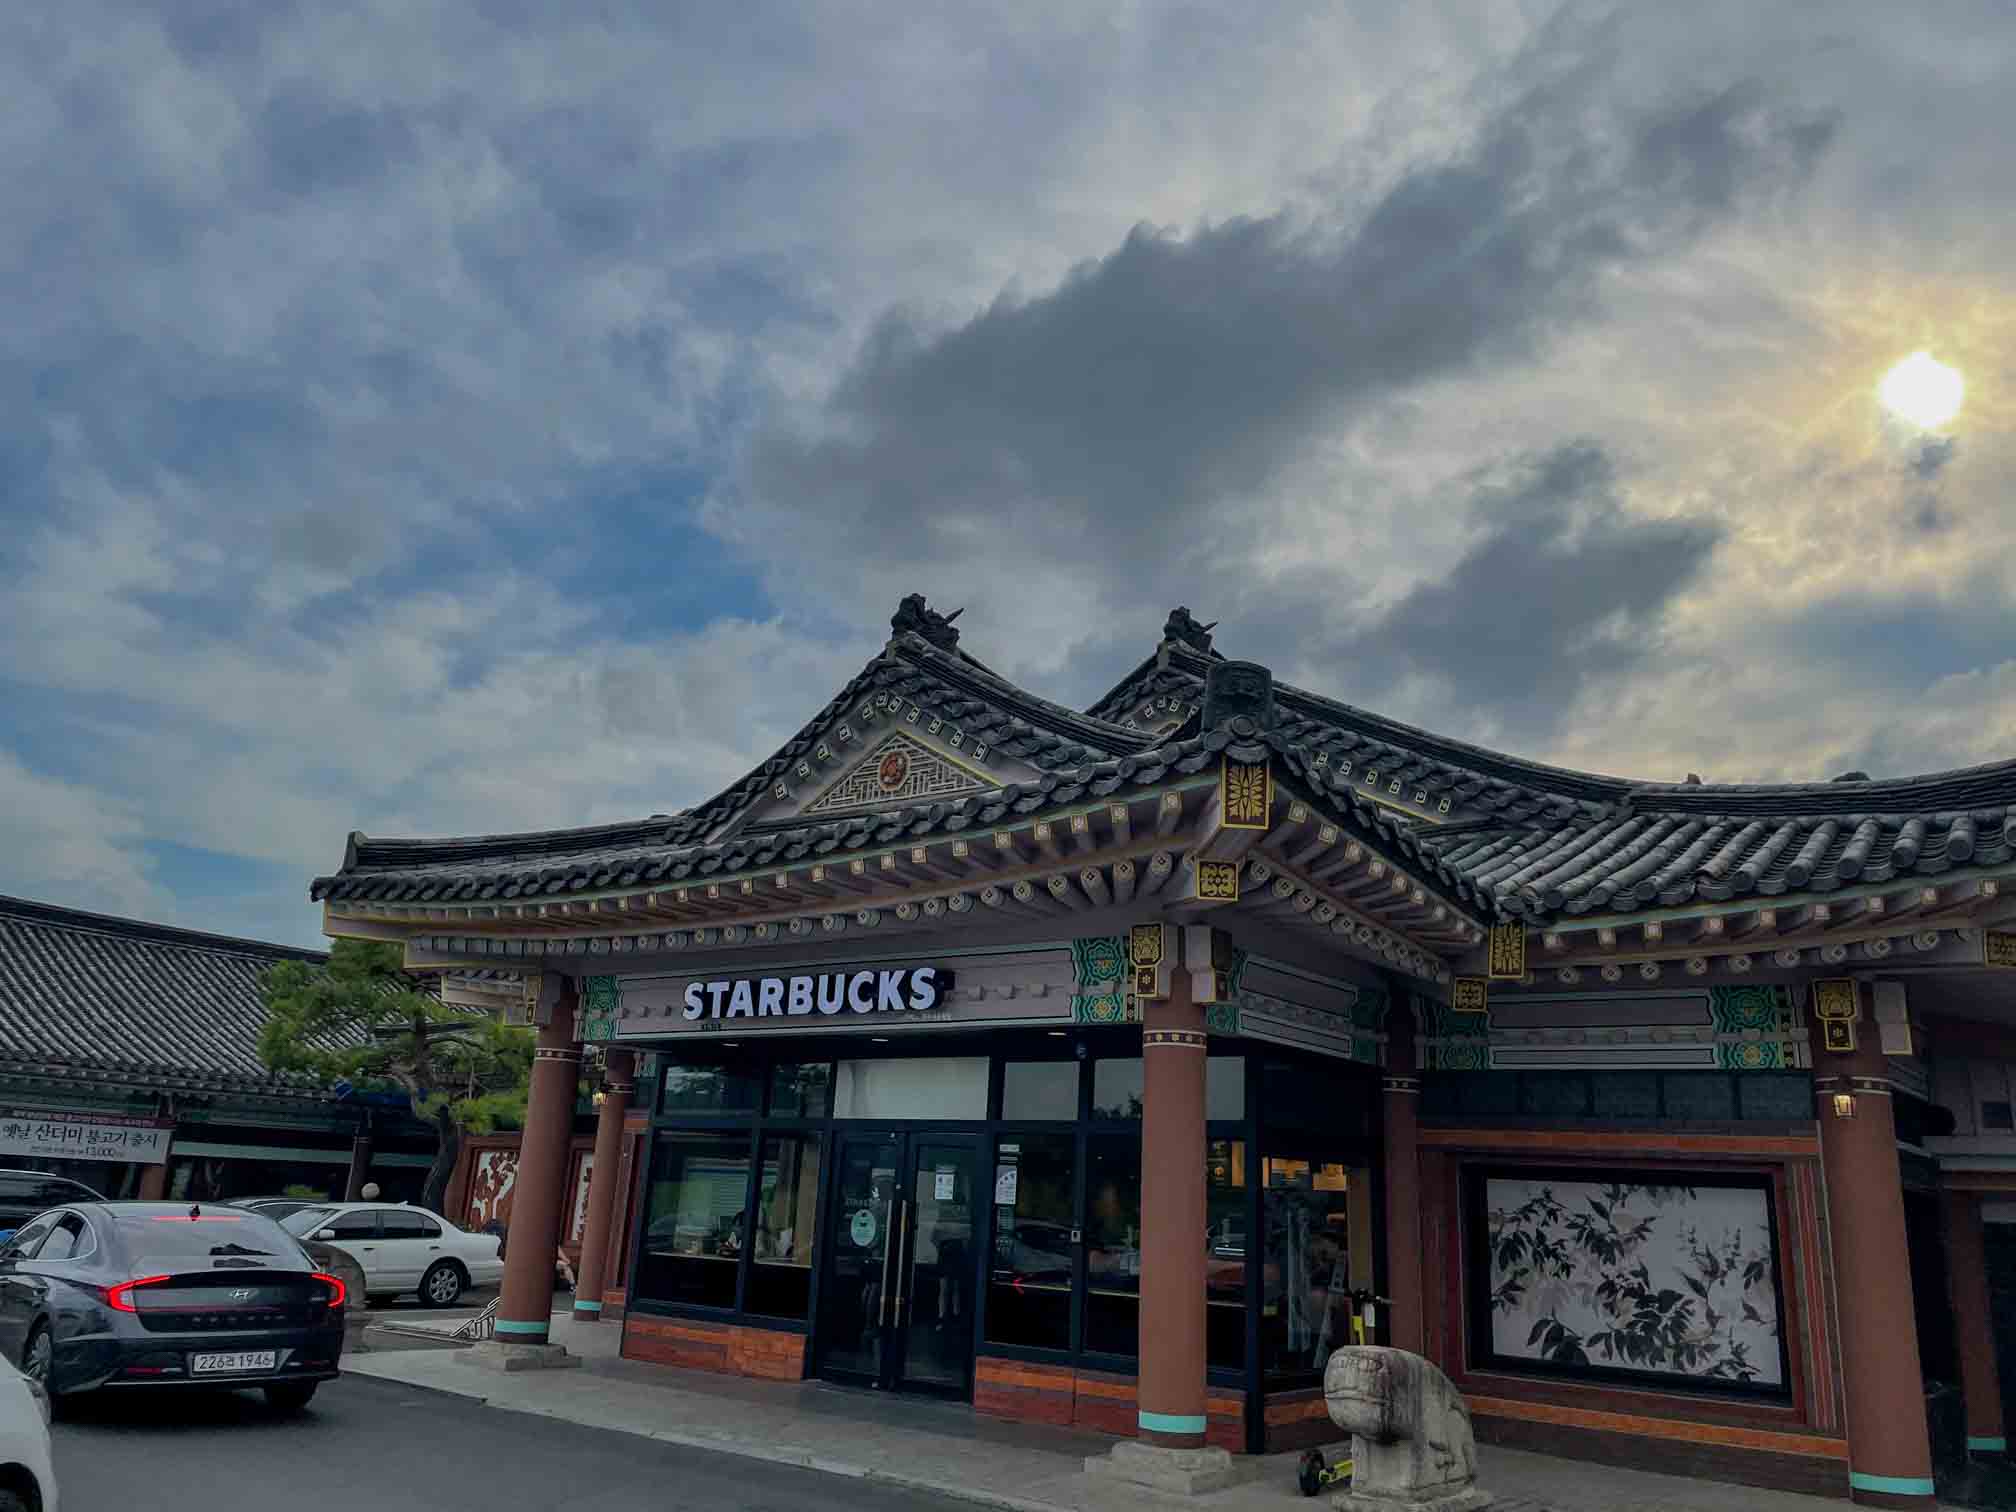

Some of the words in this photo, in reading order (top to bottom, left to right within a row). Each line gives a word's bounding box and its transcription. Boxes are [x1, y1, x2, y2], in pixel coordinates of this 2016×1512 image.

[683, 967, 936, 1021] STARBUCKS
[34, 1123, 82, 1144] 산더미
[86, 1129, 128, 1145] 불고기
